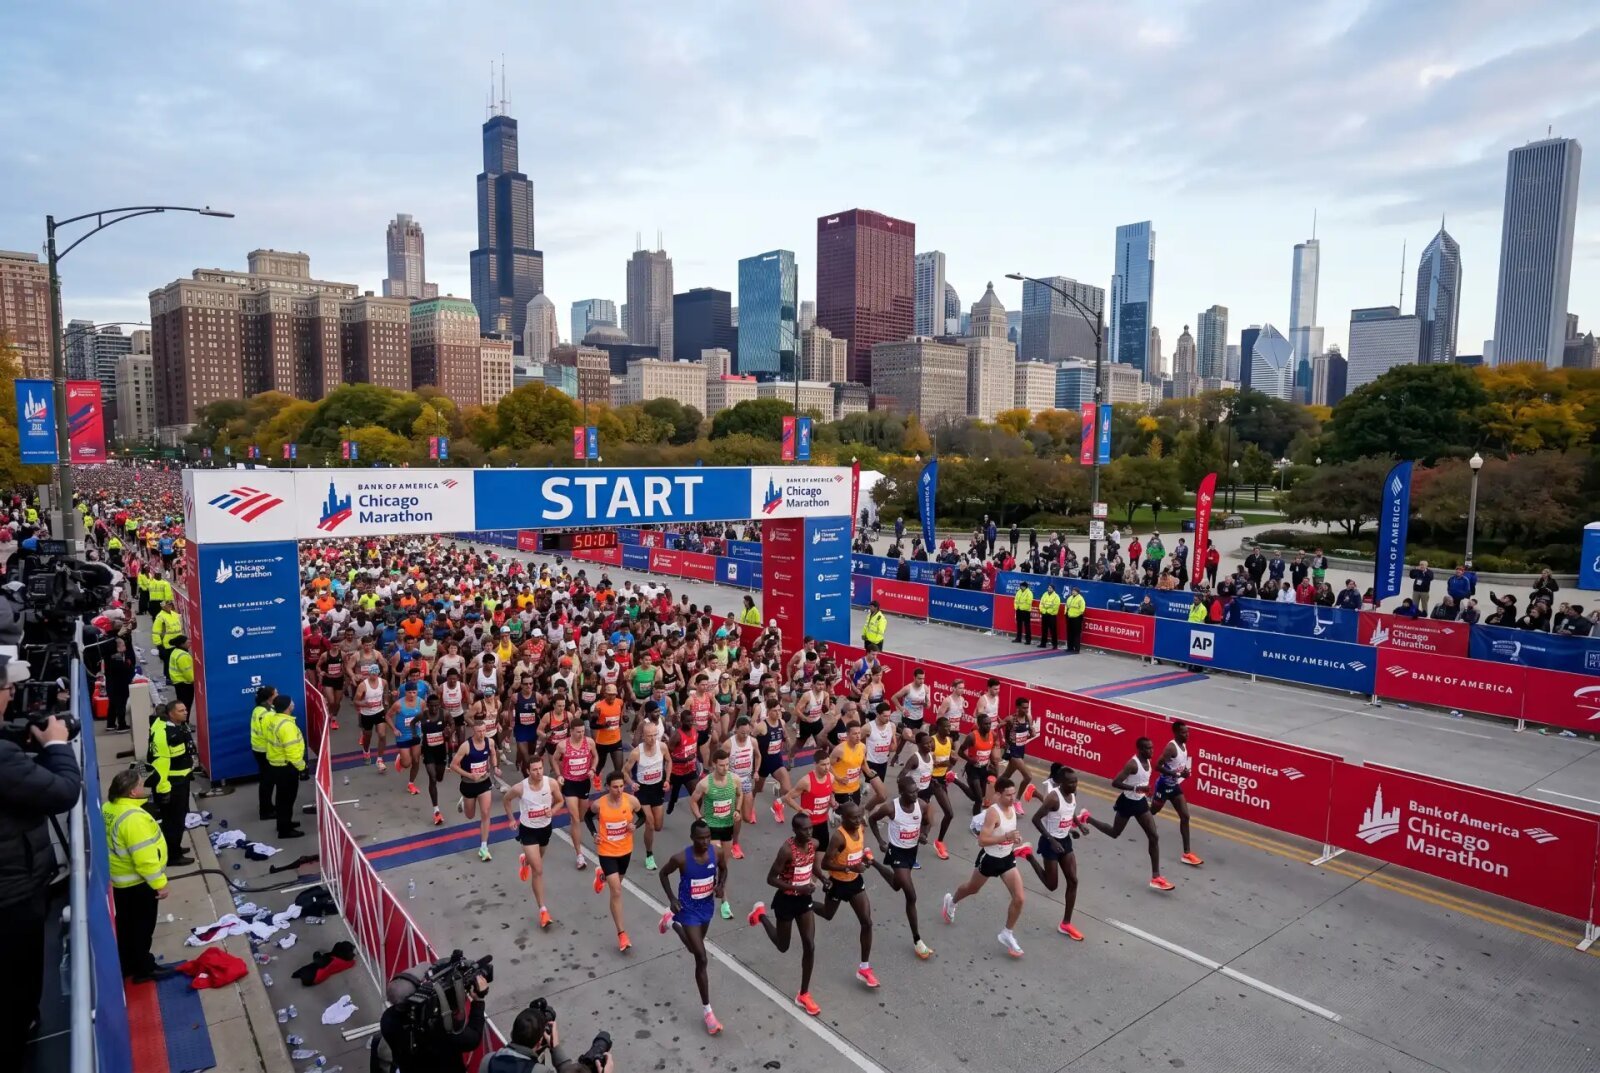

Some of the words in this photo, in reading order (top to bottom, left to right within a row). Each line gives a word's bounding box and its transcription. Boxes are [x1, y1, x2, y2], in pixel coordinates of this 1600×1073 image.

[358, 494, 419, 509] Chicago
[541, 476, 704, 520] START
[786, 486, 822, 498] Chicago
[786, 499, 829, 507] Marathon
[359, 510, 433, 523] Marathon
[1391, 498, 1401, 544] AMERICA
[1390, 547, 1398, 560] OF
[235, 571, 272, 579] Marathon
[1387, 562, 1396, 591] BANK
[931, 599, 947, 607] BANK
[954, 602, 978, 611] AMERICA
[1192, 637, 1212, 651] AP
[1391, 638, 1436, 651] Marathon
[1392, 629, 1429, 642] Chicago
[1262, 650, 1288, 661] BANK
[1302, 656, 1346, 670] AMERICA
[1412, 672, 1441, 683] BANK
[1444, 677, 1458, 685] OF
[1460, 680, 1513, 694] AMERICA
[1045, 709, 1065, 722] Bank
[1065, 715, 1074, 724] of
[1073, 717, 1106, 732] America
[1045, 722, 1092, 745] Chicago
[1044, 736, 1101, 762] Marathon
[1199, 748, 1223, 763] Bank
[1224, 756, 1235, 766] of
[1235, 758, 1279, 776] America
[1198, 762, 1258, 790] Chicago
[1197, 778, 1271, 810] Marathon
[1409, 800, 1442, 818] Bank
[1443, 811, 1459, 822] of
[1460, 813, 1520, 838] America
[1408, 816, 1490, 851] Chicago
[1406, 834, 1509, 878] Marathon
